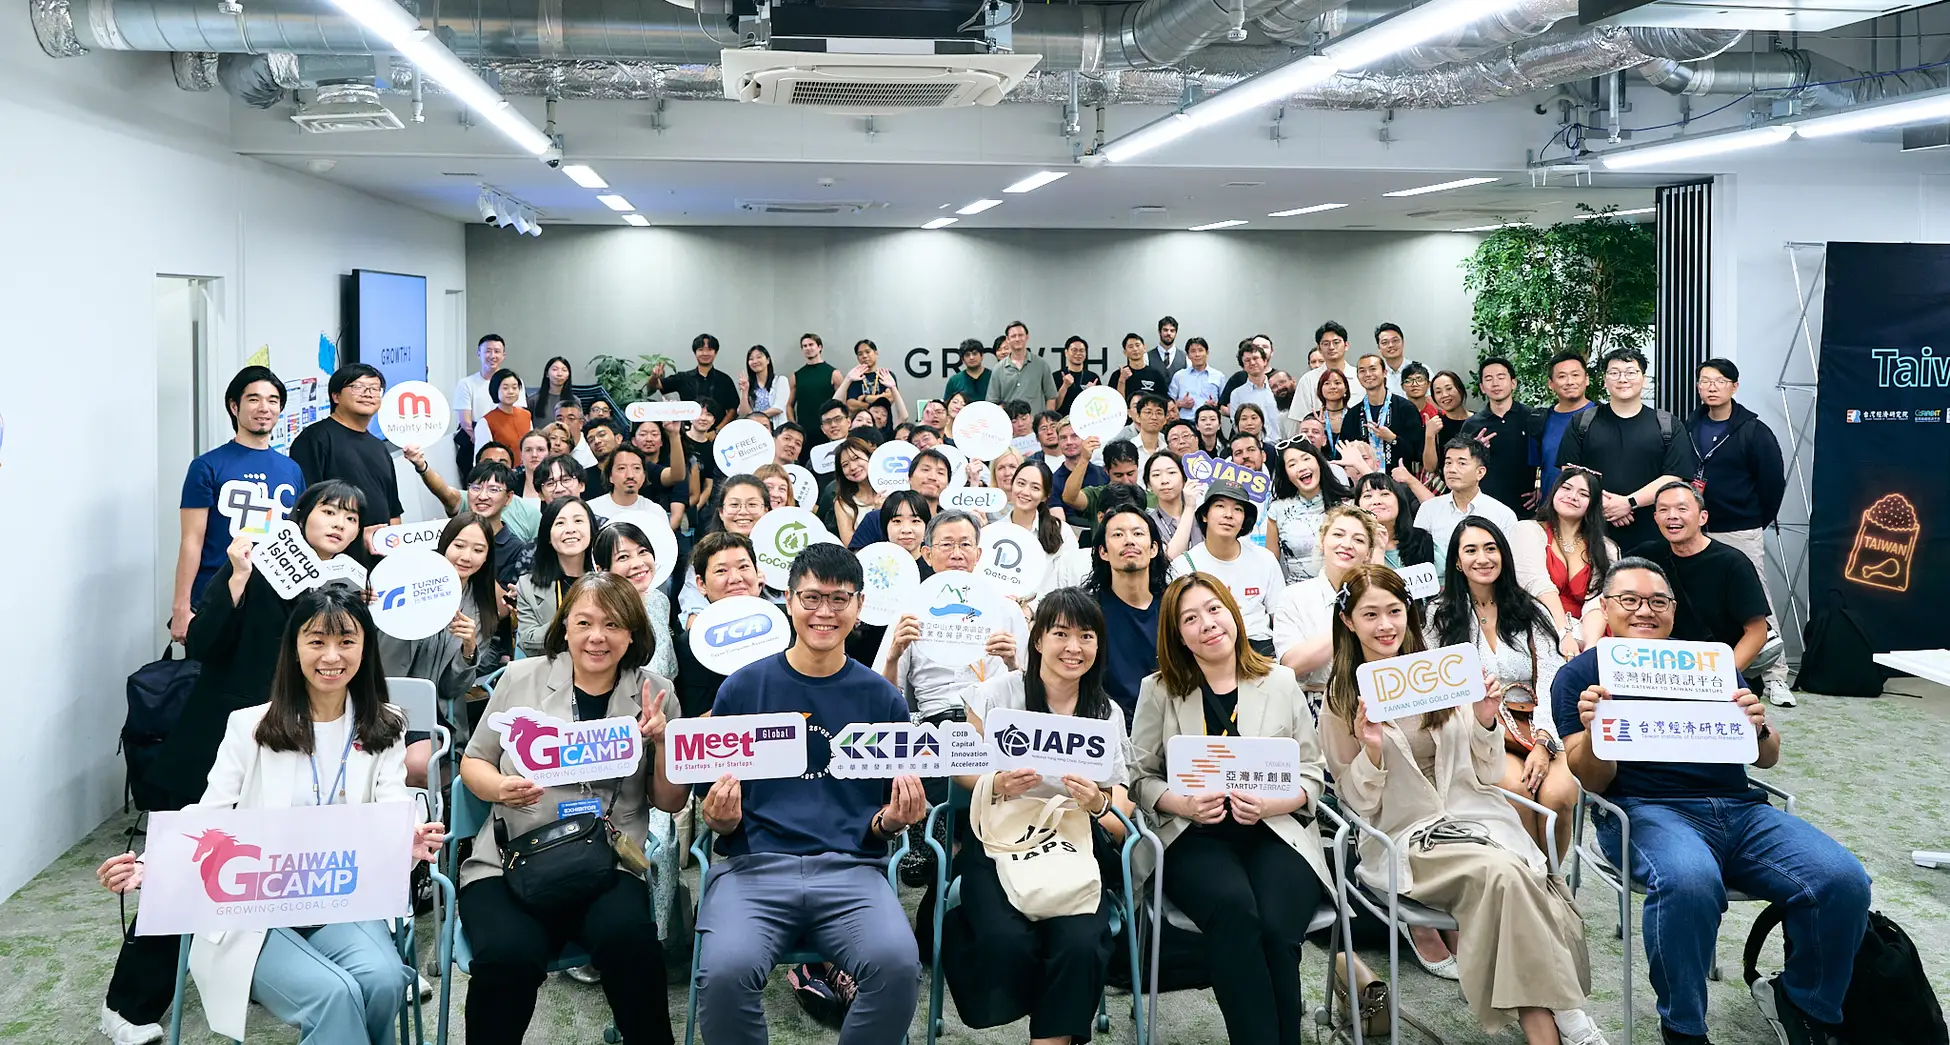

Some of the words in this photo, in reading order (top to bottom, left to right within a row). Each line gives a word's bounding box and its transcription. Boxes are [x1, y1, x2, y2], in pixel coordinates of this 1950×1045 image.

[387, 422, 421, 433] Mighty
[425, 421, 442, 431] Net
[735, 436, 757, 450] FREE
[738, 442, 768, 457] Bionics
[1213, 462, 1267, 493] IAPS
[278, 528, 320, 579] Startup
[1863, 535, 1908, 556] TAIWAN
[267, 541, 311, 584] Island
[412, 576, 449, 590] TURING
[413, 585, 443, 598] DRIVE
[712, 620, 763, 645] TCA
[1372, 654, 1467, 703] DGC
[1612, 671, 1724, 688] 臺灣新創資訊平台
[1383, 702, 1411, 713] TAIWAN
[1413, 699, 1428, 708] DIGI
[1429, 694, 1449, 704] GOLD
[1451, 689, 1471, 700] CARD
[564, 725, 630, 746] TAIWAN
[1638, 720, 1745, 736] 台灣經濟研究院
[563, 739, 631, 765] CAMP
[674, 731, 755, 761] Meet
[762, 729, 789, 739] Global
[1033, 729, 1106, 758] IAPS
[533, 768, 576, 781] GROWING
[579, 764, 613, 775] GLOBAL
[685, 762, 713, 770] Startups.
[727, 760, 755, 768] Startups.
[1226, 770, 1291, 783] 亞灣新創園
[1226, 782, 1258, 790] STARTUP
[1012, 841, 1077, 860] IAPS
[268, 850, 357, 873] TAIWAN
[261, 870, 353, 898] CAMP
